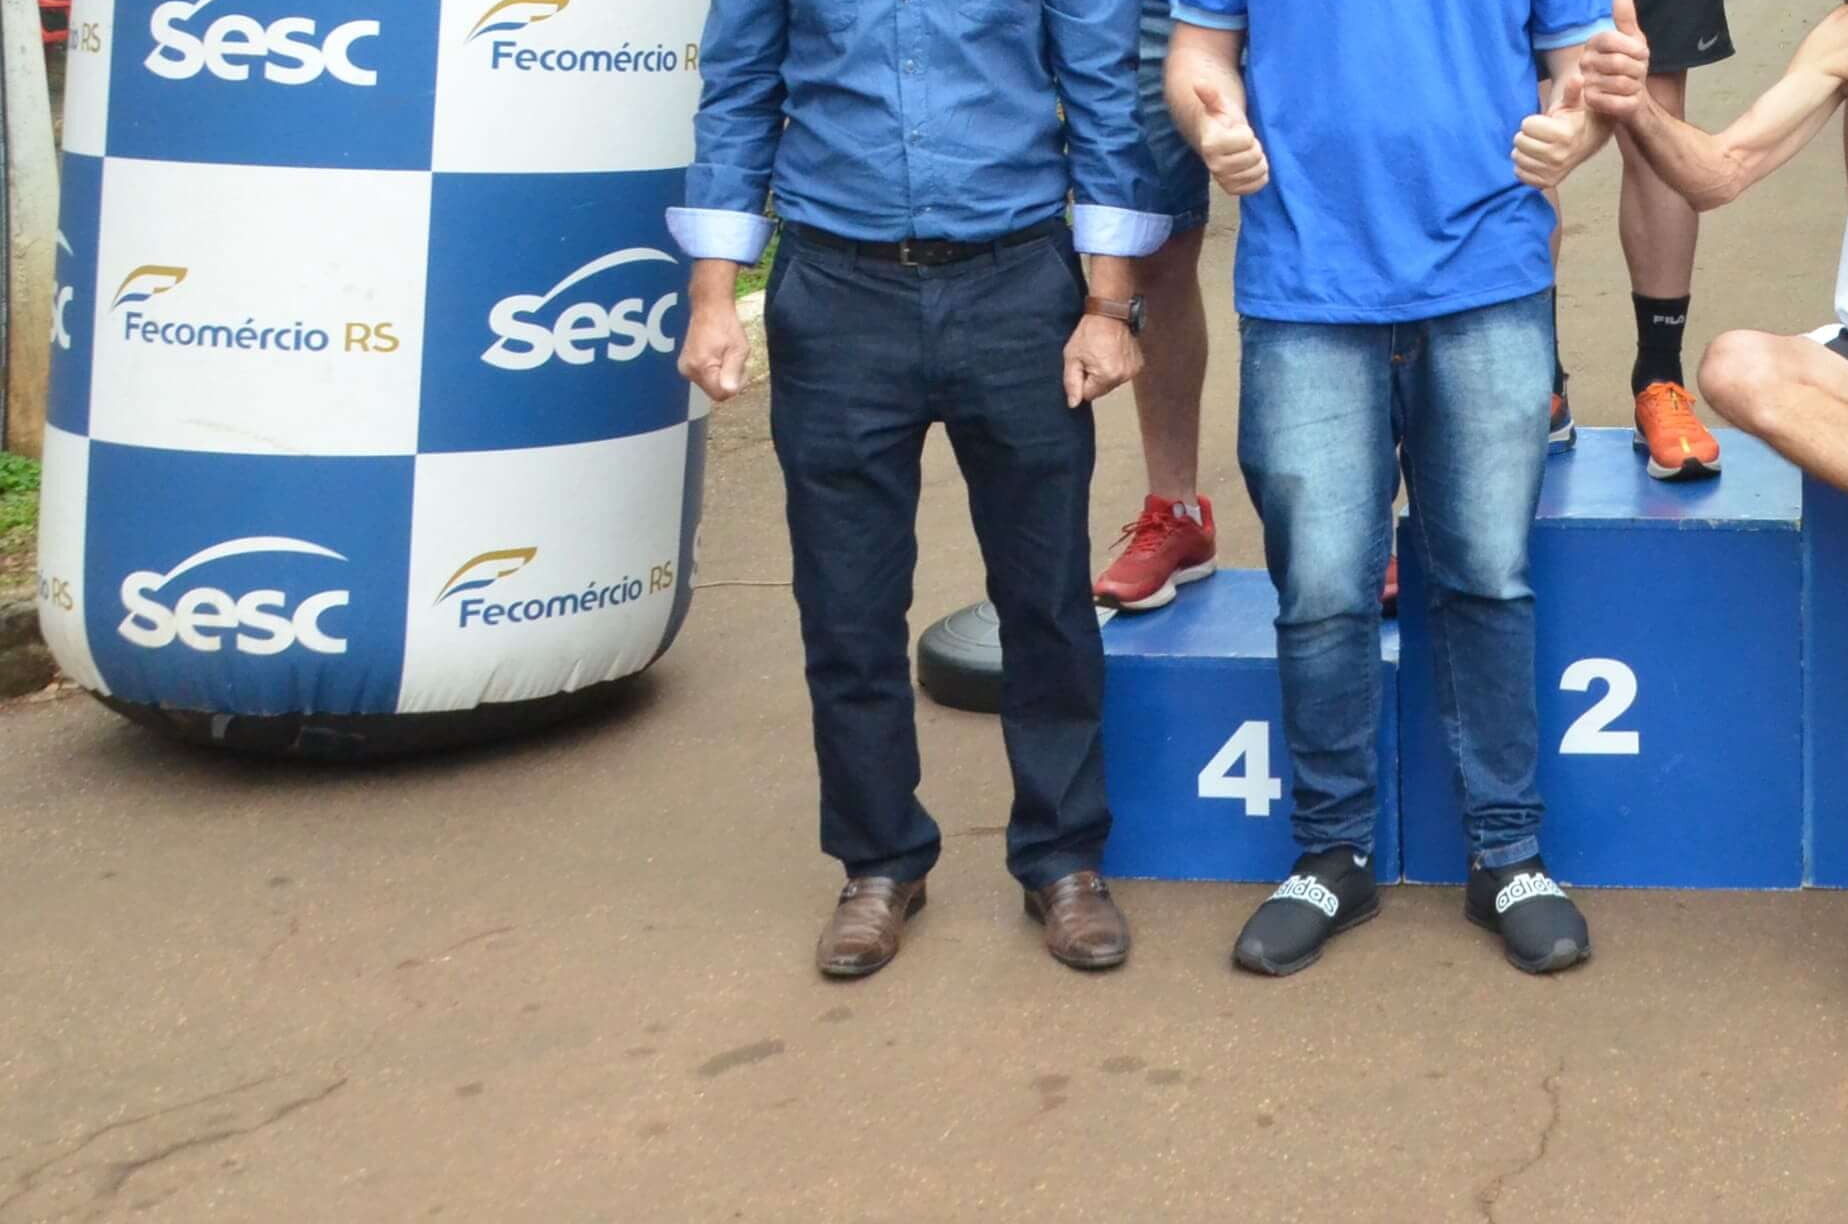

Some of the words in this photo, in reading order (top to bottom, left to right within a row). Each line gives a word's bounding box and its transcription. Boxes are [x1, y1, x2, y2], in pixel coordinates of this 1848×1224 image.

[491, 40, 678, 72] Fecomércio
[684, 42, 699, 71] R
[124, 310, 328, 353] Fecomércio
[344, 321, 400, 353] RS
[459, 573, 643, 629] Fecomércio
[648, 562, 673, 593] RS
[1558, 658, 1640, 755] 2
[1197, 720, 1282, 816] 4
